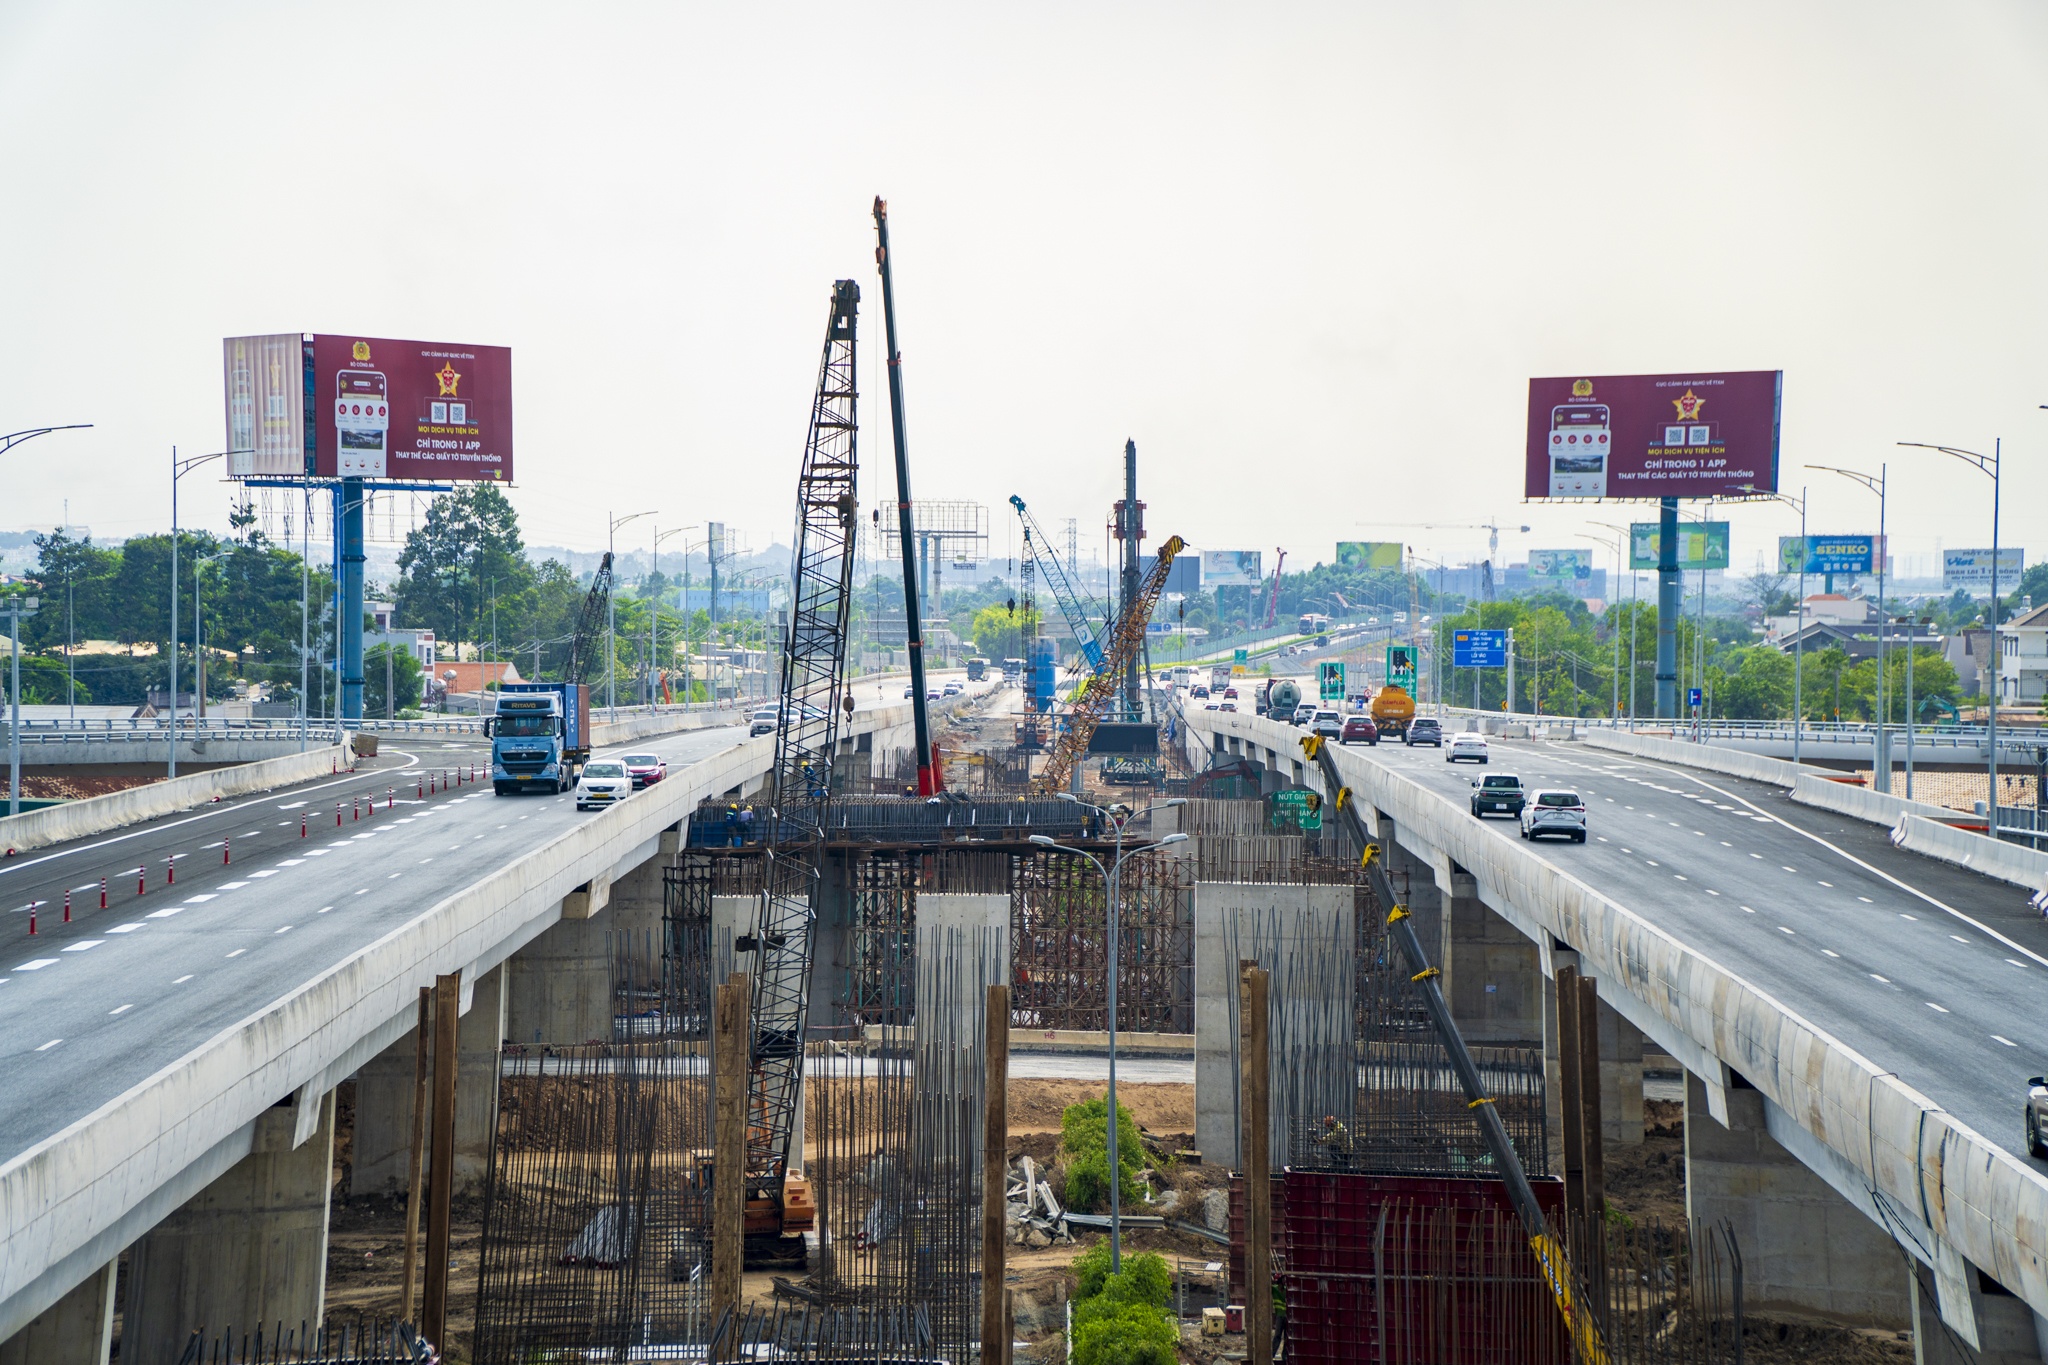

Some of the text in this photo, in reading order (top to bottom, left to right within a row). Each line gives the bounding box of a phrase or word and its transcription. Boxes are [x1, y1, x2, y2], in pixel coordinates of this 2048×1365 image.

[416, 437, 480, 450] CHỈ TRONG 1 APP
[411, 451, 422, 459] THẾ
[422, 451, 435, 460] CÁC
[436, 452, 450, 460] GIẤY
[460, 452, 480, 461] TRUYỀN
[481, 453, 502, 462] THỐNG
[1645, 459, 1727, 469] CHỈ TRONG 1 APP
[1637, 471, 1650, 479] THẾ
[1651, 471, 1667, 479] CÁC
[1669, 470, 1687, 479] GIẤY
[1700, 470, 1726, 478] TRUYỀN
[1728, 469, 1754, 478] THỐNG
[1816, 545, 1868, 555] SENKO
[1278, 792, 1293, 800] NÚT
